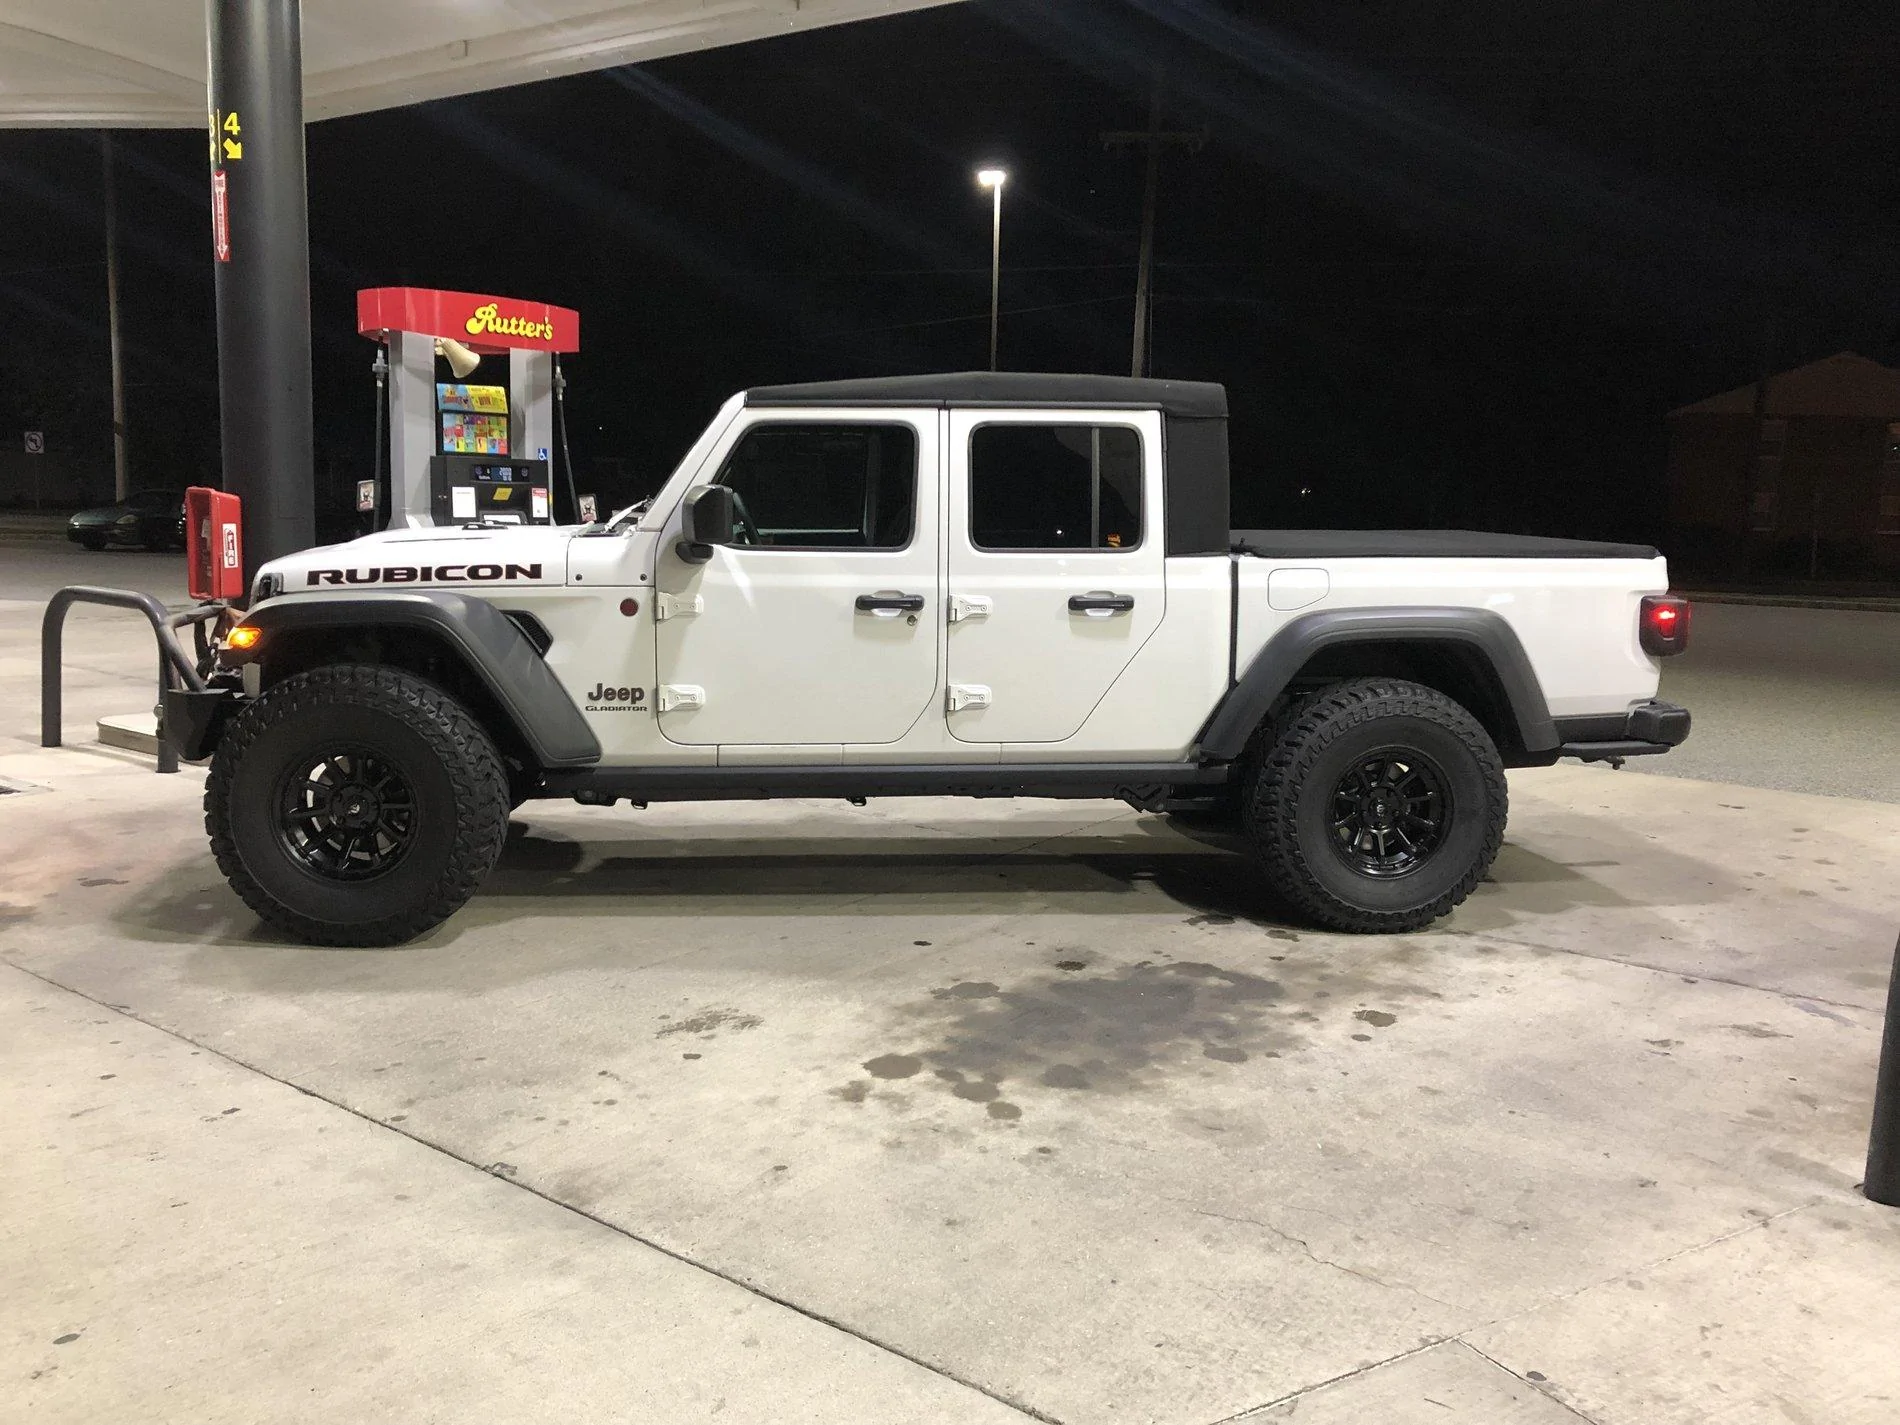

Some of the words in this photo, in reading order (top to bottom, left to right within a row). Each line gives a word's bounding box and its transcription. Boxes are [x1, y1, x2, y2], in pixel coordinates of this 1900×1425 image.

[223, 112, 240, 135] 4
[466, 303, 553, 340] Rutter's
[307, 563, 543, 586] RUBICON
[588, 683, 645, 705] Jeep
